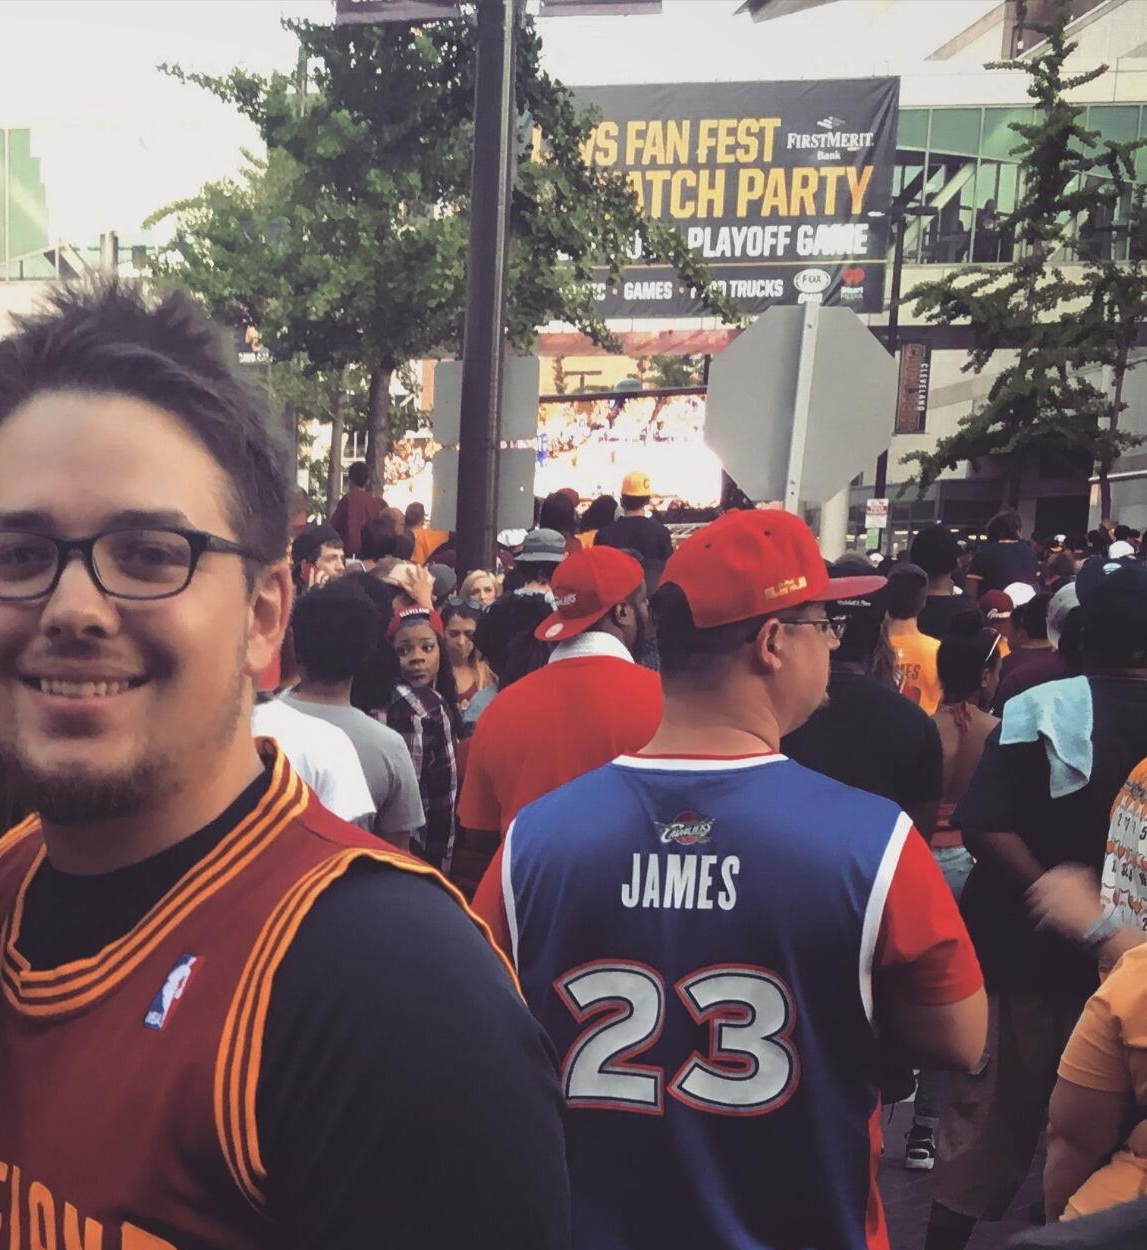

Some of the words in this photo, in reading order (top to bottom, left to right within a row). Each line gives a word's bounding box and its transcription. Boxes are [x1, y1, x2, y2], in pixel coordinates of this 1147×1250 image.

[624, 119, 689, 165] FAN
[696, 117, 782, 164] FEST
[817, 150, 841, 160] Bank
[595, 169, 726, 219] ATCH
[736, 165, 874, 218] PARTY
[687, 226, 792, 258] PLAYOFF
[623, 281, 673, 301] GAMES
[729, 279, 784, 298] TRUCKS
[918, 362, 929, 411] CLEVELAND
[621, 853, 740, 911] JAMES
[552, 958, 801, 1117] 23
